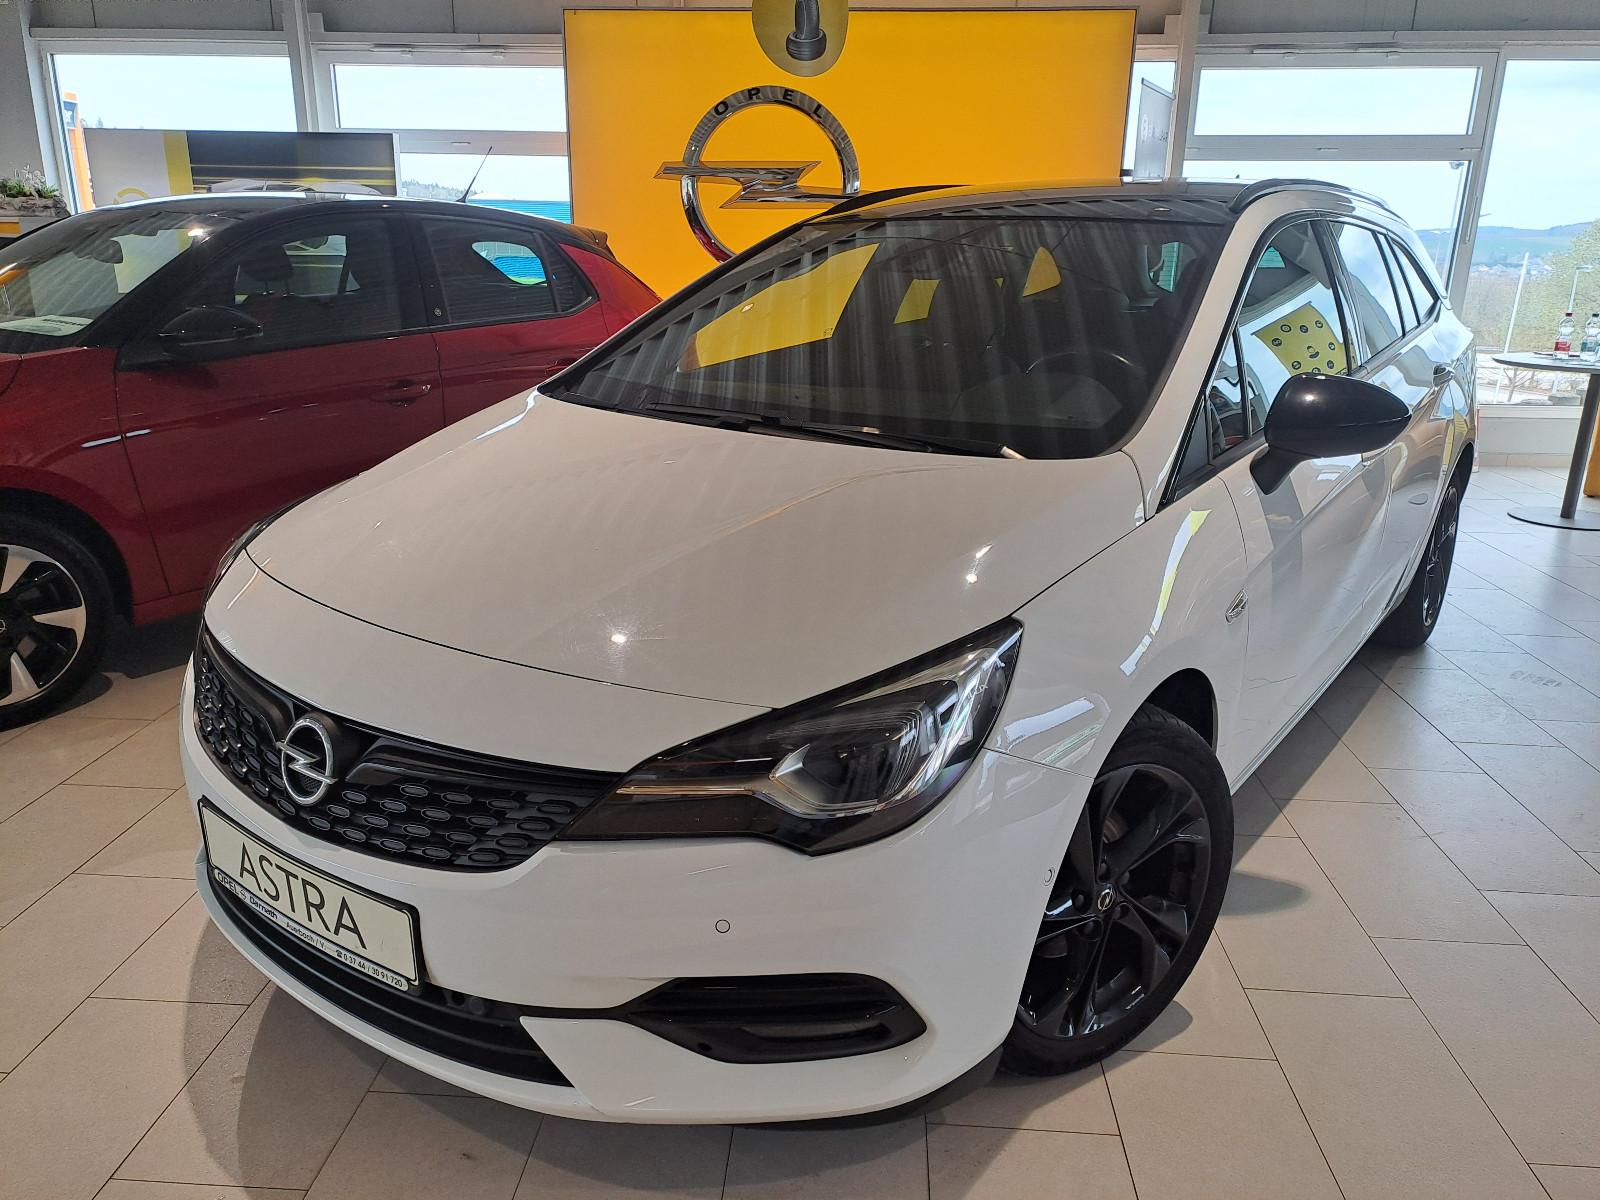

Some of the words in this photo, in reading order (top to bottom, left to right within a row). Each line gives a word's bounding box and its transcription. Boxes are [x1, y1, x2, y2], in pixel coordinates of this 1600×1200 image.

[713, 86, 824, 119] OPEL
[217, 871, 240, 895] OPEL
[239, 841, 368, 950] ASTRA
